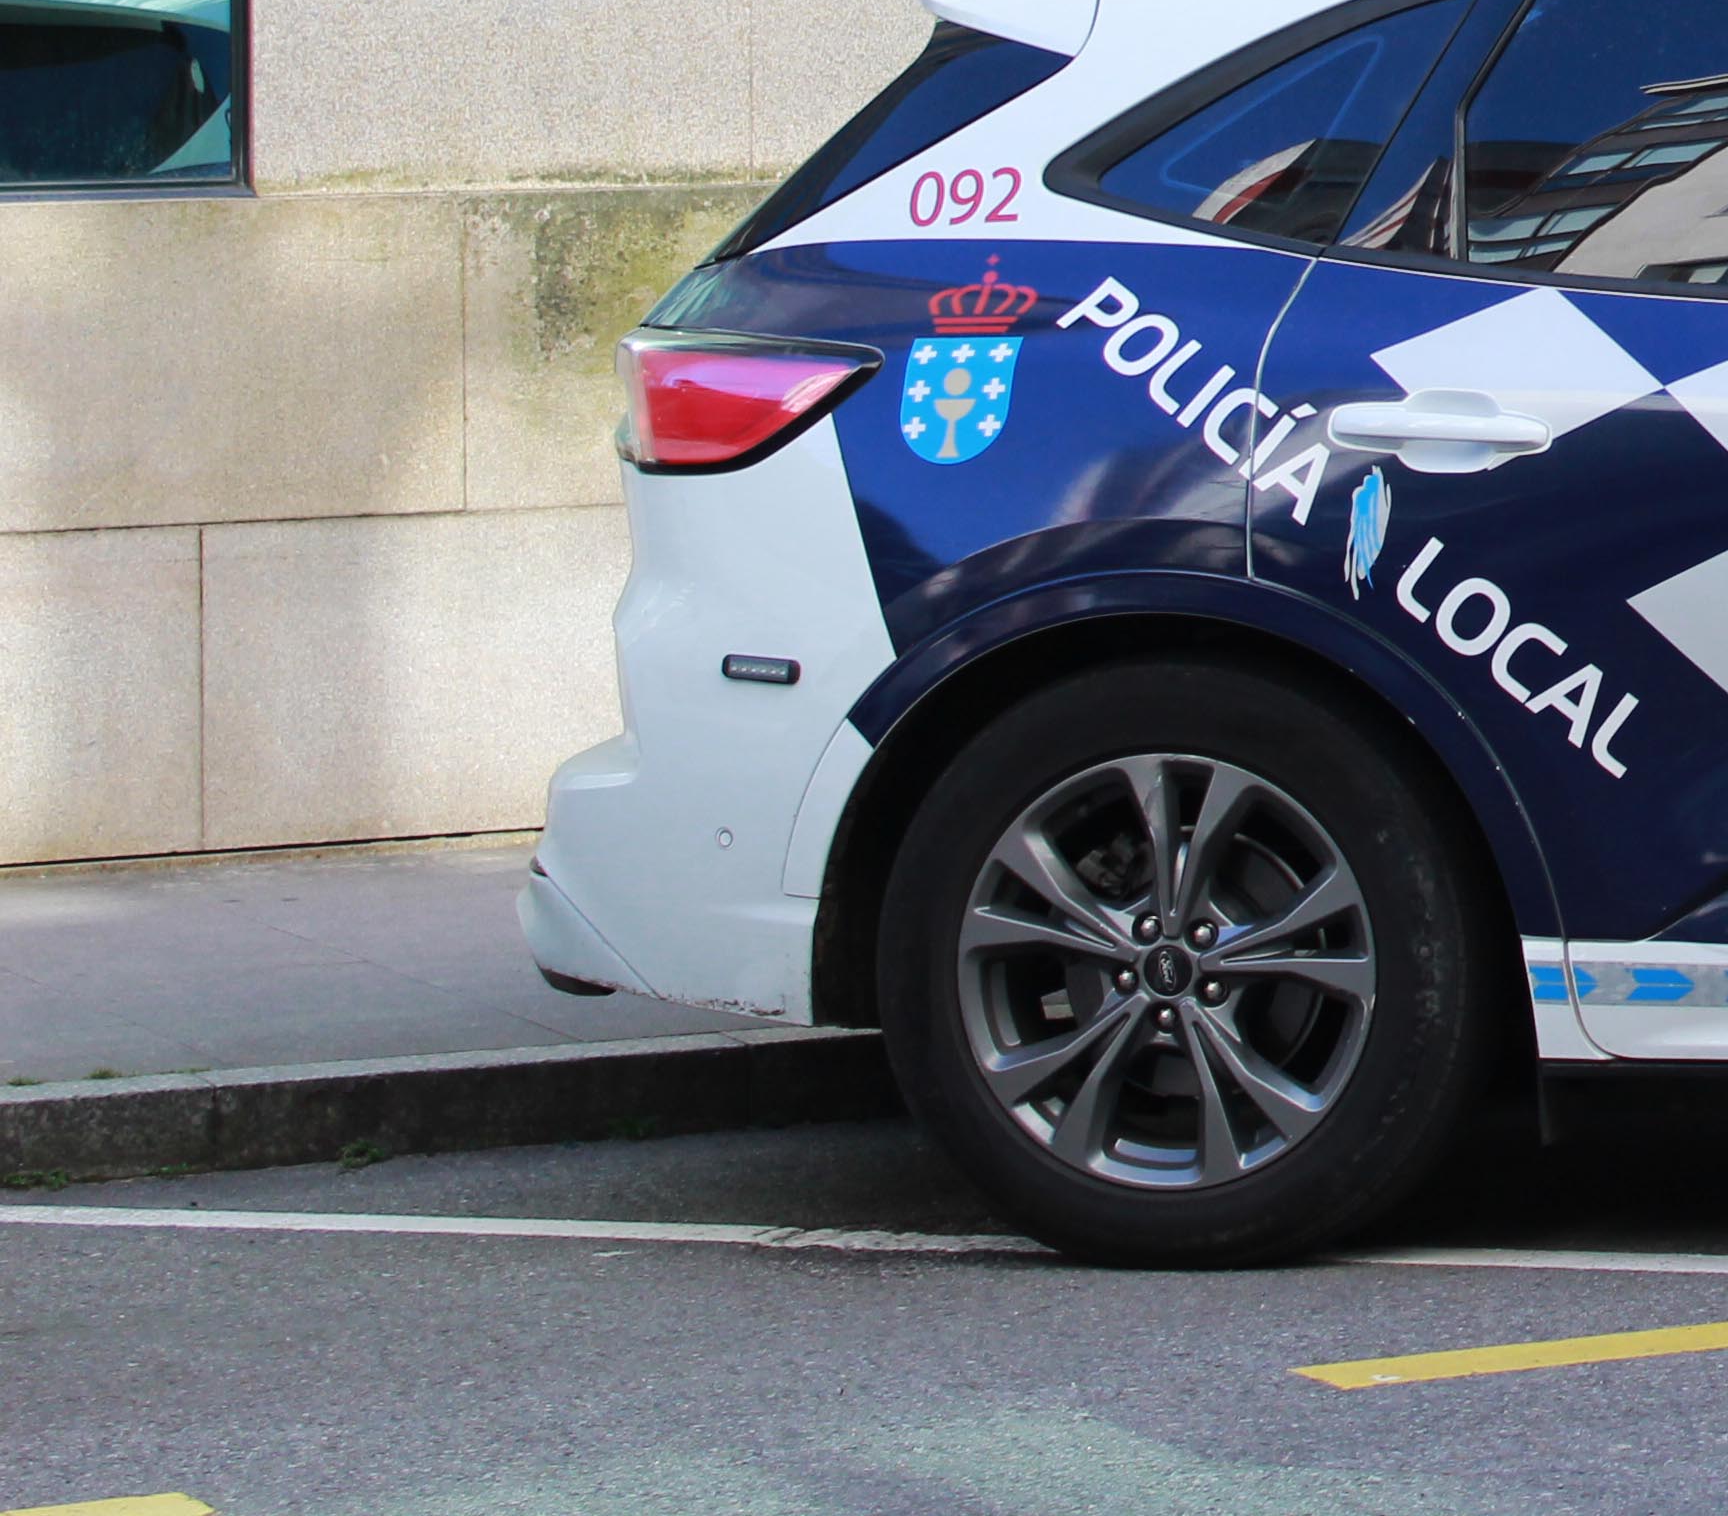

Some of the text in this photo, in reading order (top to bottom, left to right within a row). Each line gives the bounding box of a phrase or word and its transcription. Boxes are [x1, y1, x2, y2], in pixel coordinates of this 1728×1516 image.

[909, 167, 1022, 226] 092
[1057, 277, 1640, 779] POLICÍA LOCAL
